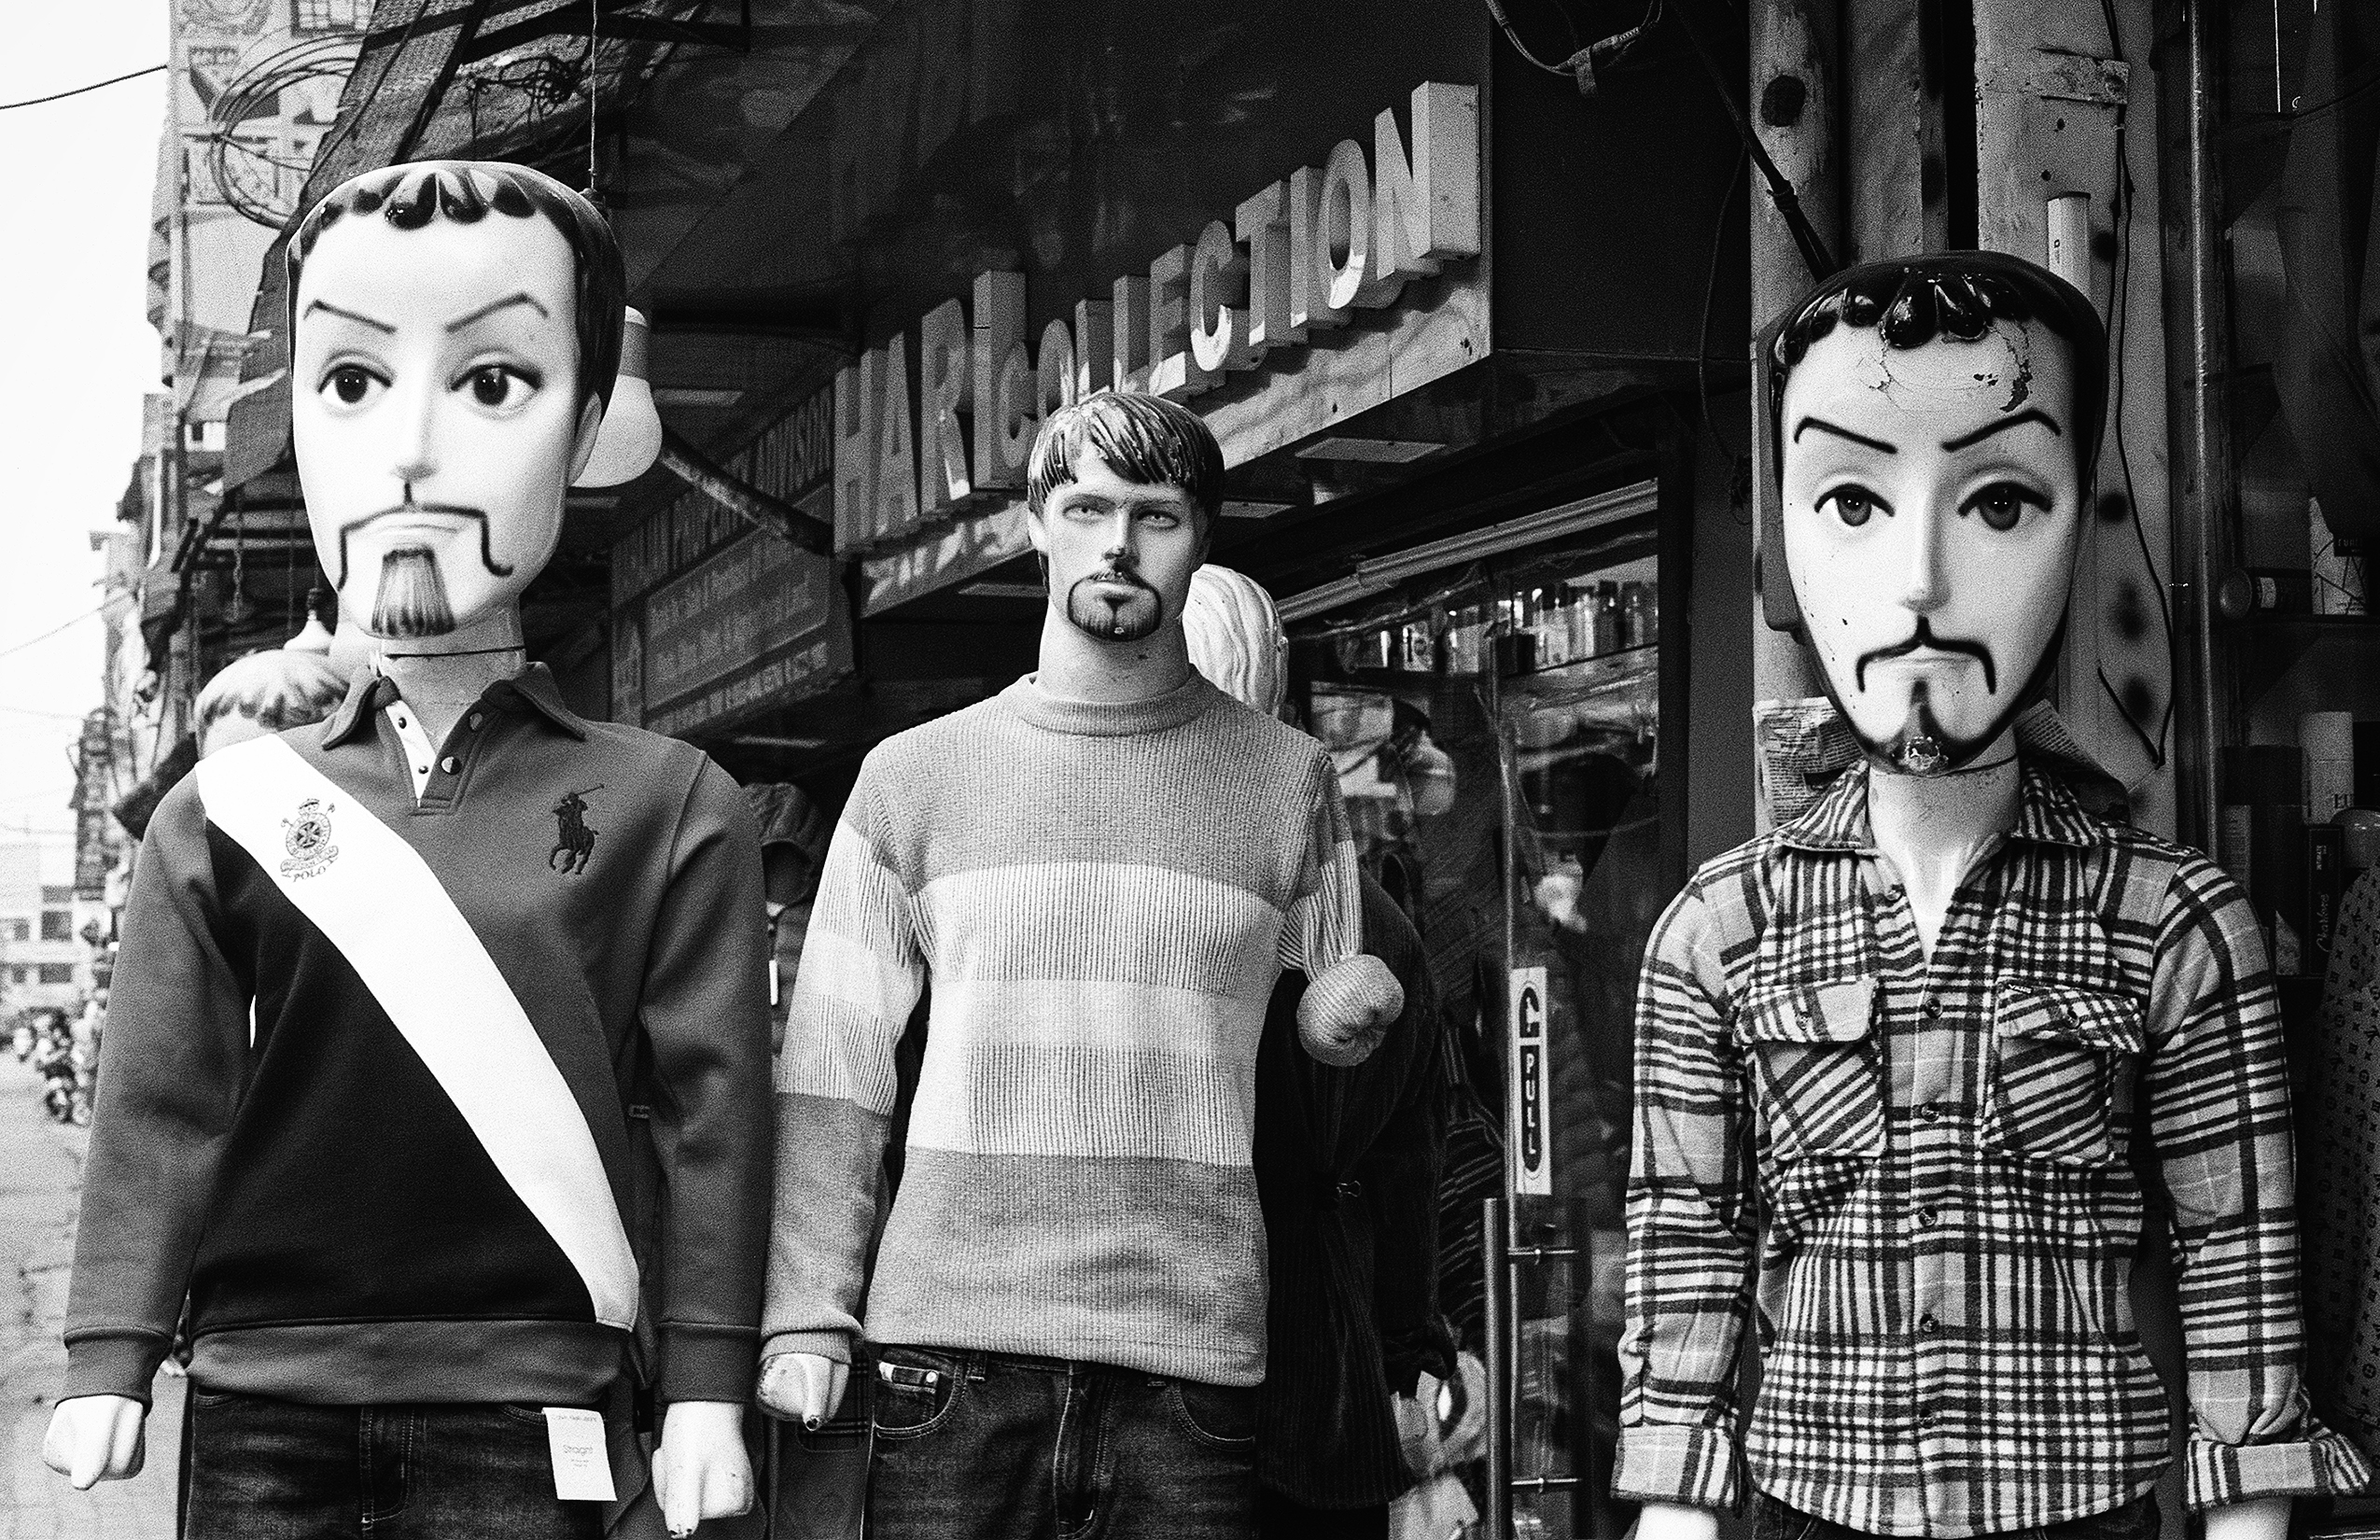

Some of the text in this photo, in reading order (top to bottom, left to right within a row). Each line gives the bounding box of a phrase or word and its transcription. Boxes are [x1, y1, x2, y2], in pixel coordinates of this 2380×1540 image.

[833, 269, 1026, 553] HARI
[998, 80, 1481, 467] COLLECTION
[292, 865, 327, 883] POLO
[1525, 1053, 1536, 1155] PULL
